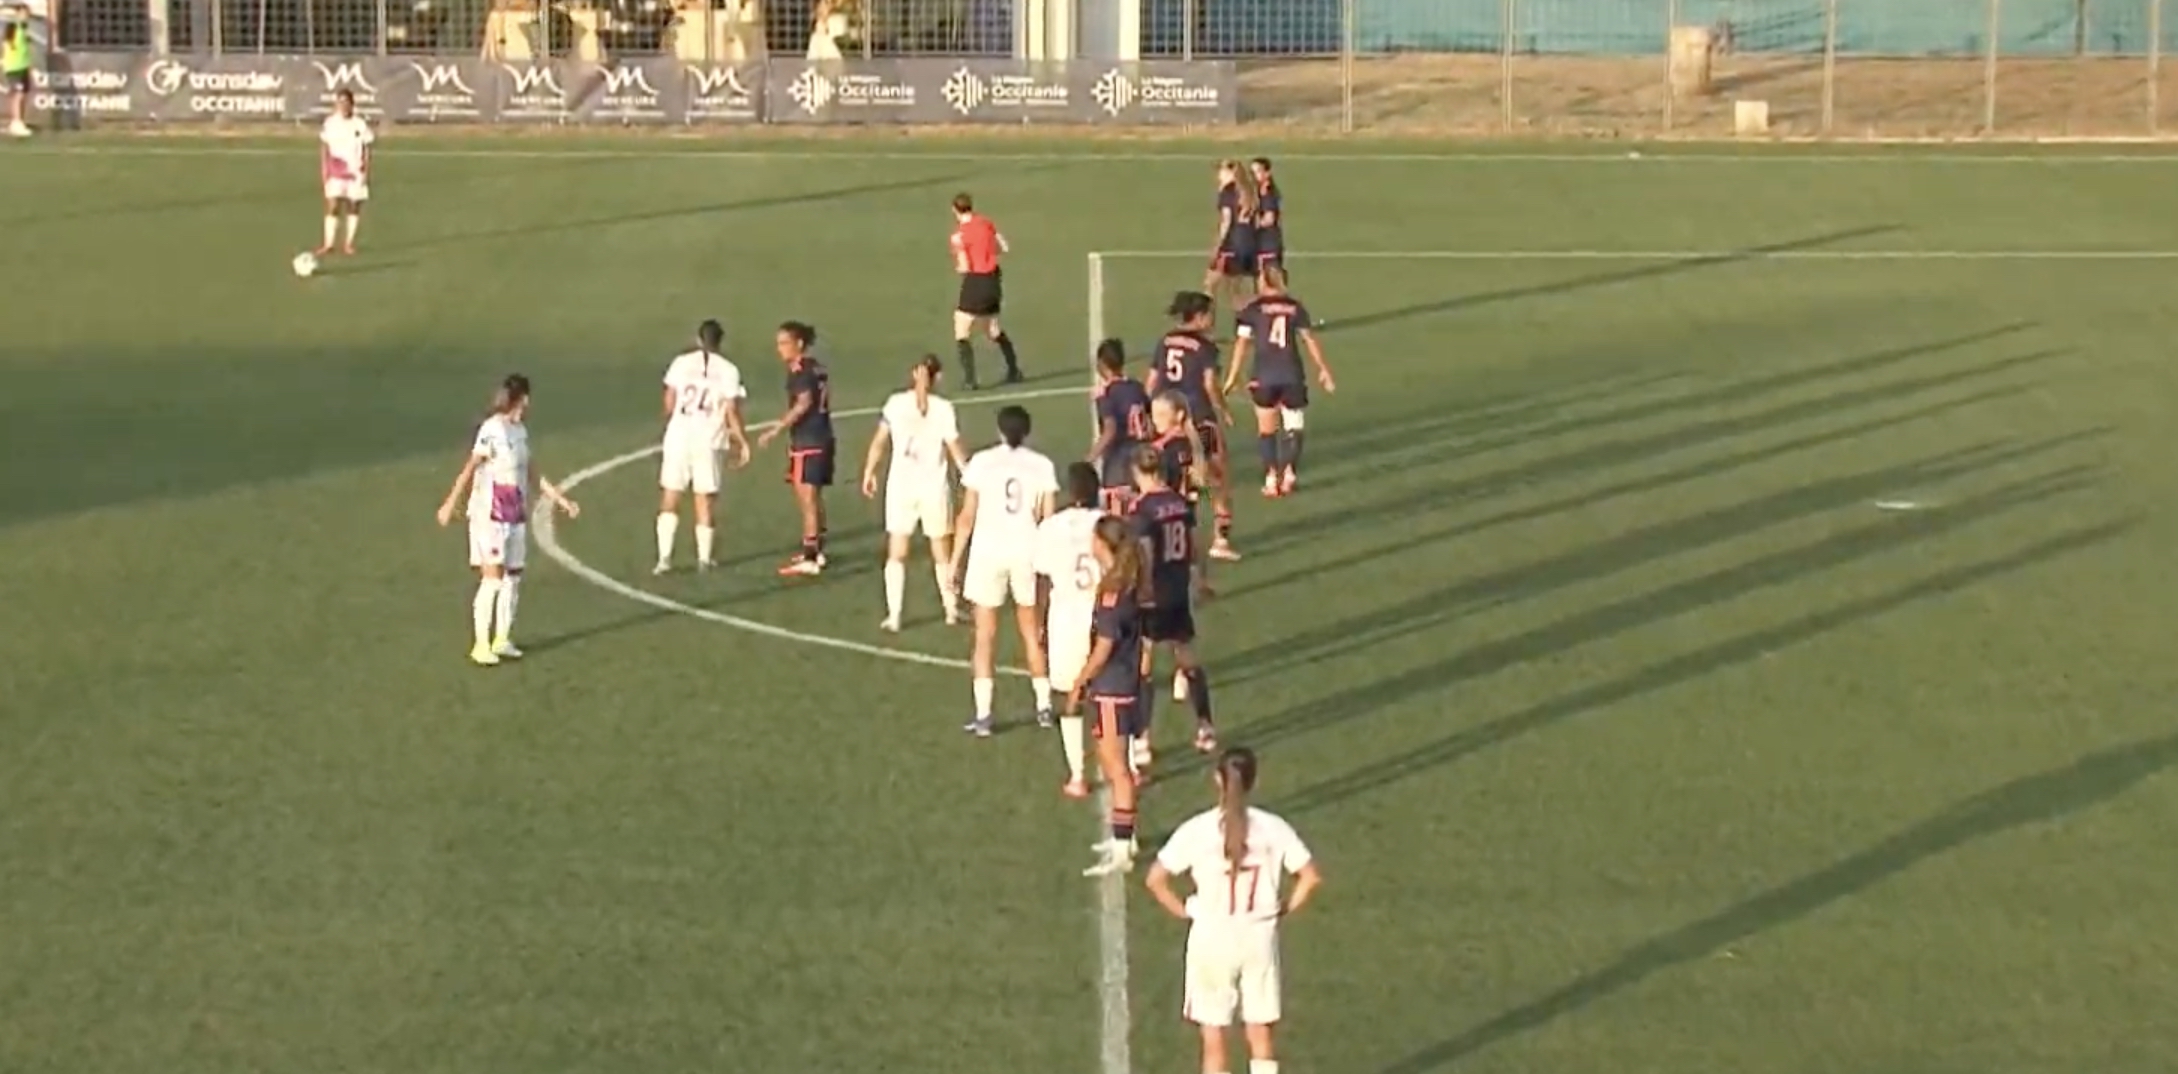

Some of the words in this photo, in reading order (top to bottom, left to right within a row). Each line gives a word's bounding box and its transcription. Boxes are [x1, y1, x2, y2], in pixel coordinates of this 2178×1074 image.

[188, 71, 284, 89] transdev
[839, 83, 915, 97] Occitanie
[991, 84, 1068, 98] Occitanie
[1142, 85, 1218, 99] Occitanie
[190, 95, 286, 111] OCCITANIE
[1268, 315, 1286, 348] 4
[1166, 349, 1184, 382] 5
[681, 384, 714, 417] 24
[1005, 477, 1022, 515] 9
[1163, 520, 1187, 562] 18
[1075, 553, 1094, 590] 5
[1225, 865, 1260, 916] 17
